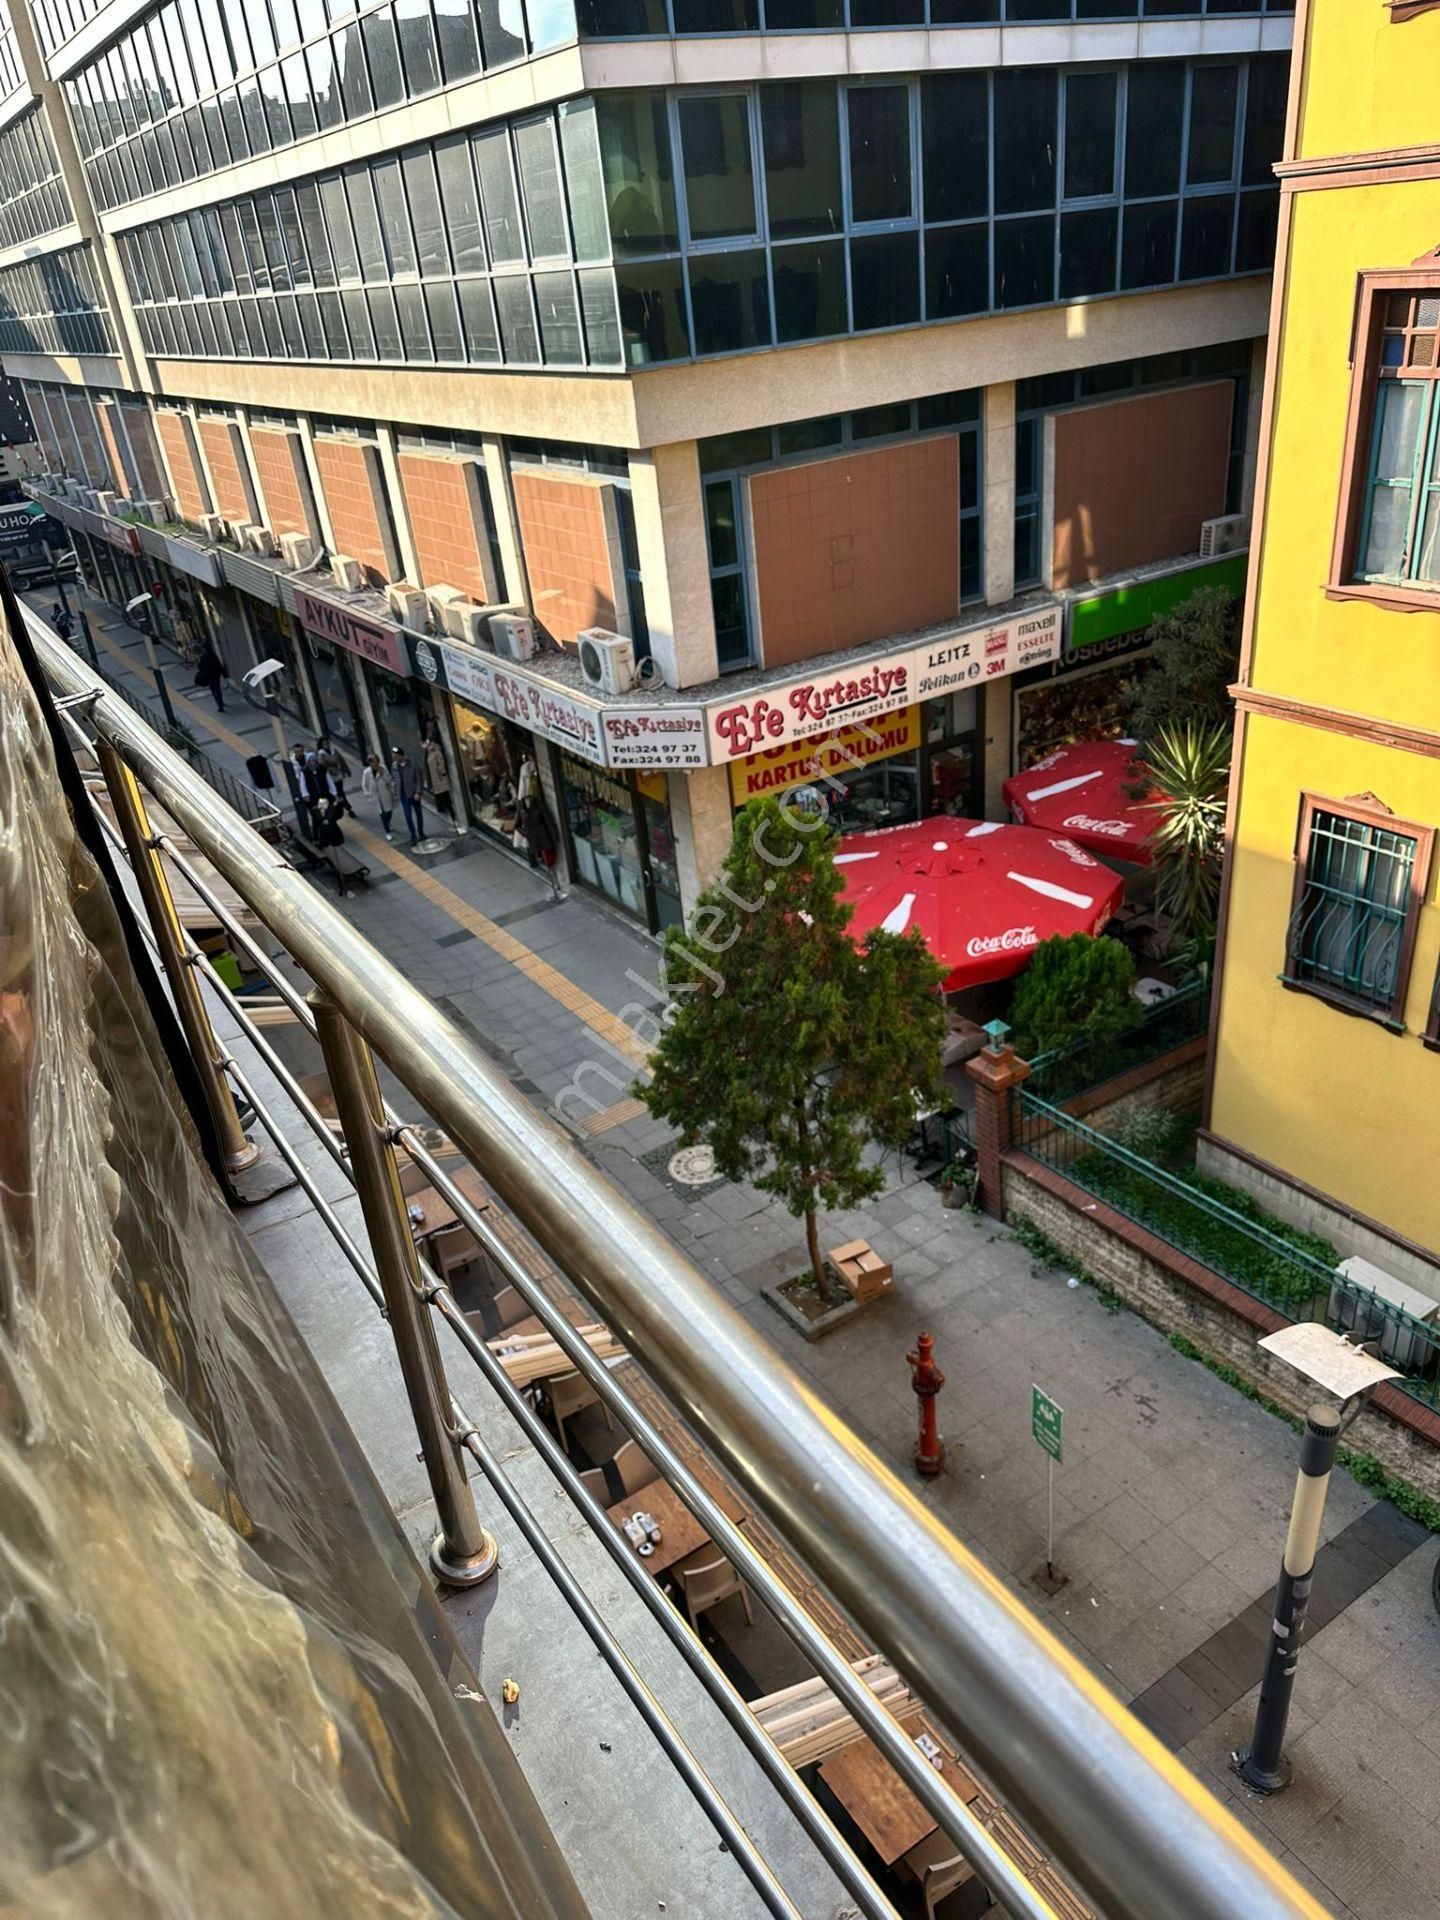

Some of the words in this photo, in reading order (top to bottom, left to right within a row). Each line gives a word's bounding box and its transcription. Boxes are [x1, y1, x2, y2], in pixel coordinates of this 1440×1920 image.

[305, 598, 384, 647] AYKUT
[1017, 613, 1056, 637] maxell
[1017, 632, 1055, 652] ESSELTE
[928, 643, 970, 668] LEITZ
[986, 658, 1006, 676] 3M
[918, 670, 965, 694] Pelikan
[494, 673, 530, 720] Efe
[715, 700, 784, 756] Efe
[789, 666, 907, 721] Kırtasiye
[606, 719, 640, 740] Efe
[612, 744, 658, 754] Tel:324
[662, 744, 677, 753] 97
[682, 744, 697, 752] 37
[829, 726, 908, 767] DOLUMU
[613, 756, 662, 765] Fax:324
[665, 755, 681, 764] 97
[685, 755, 701, 764] 88
